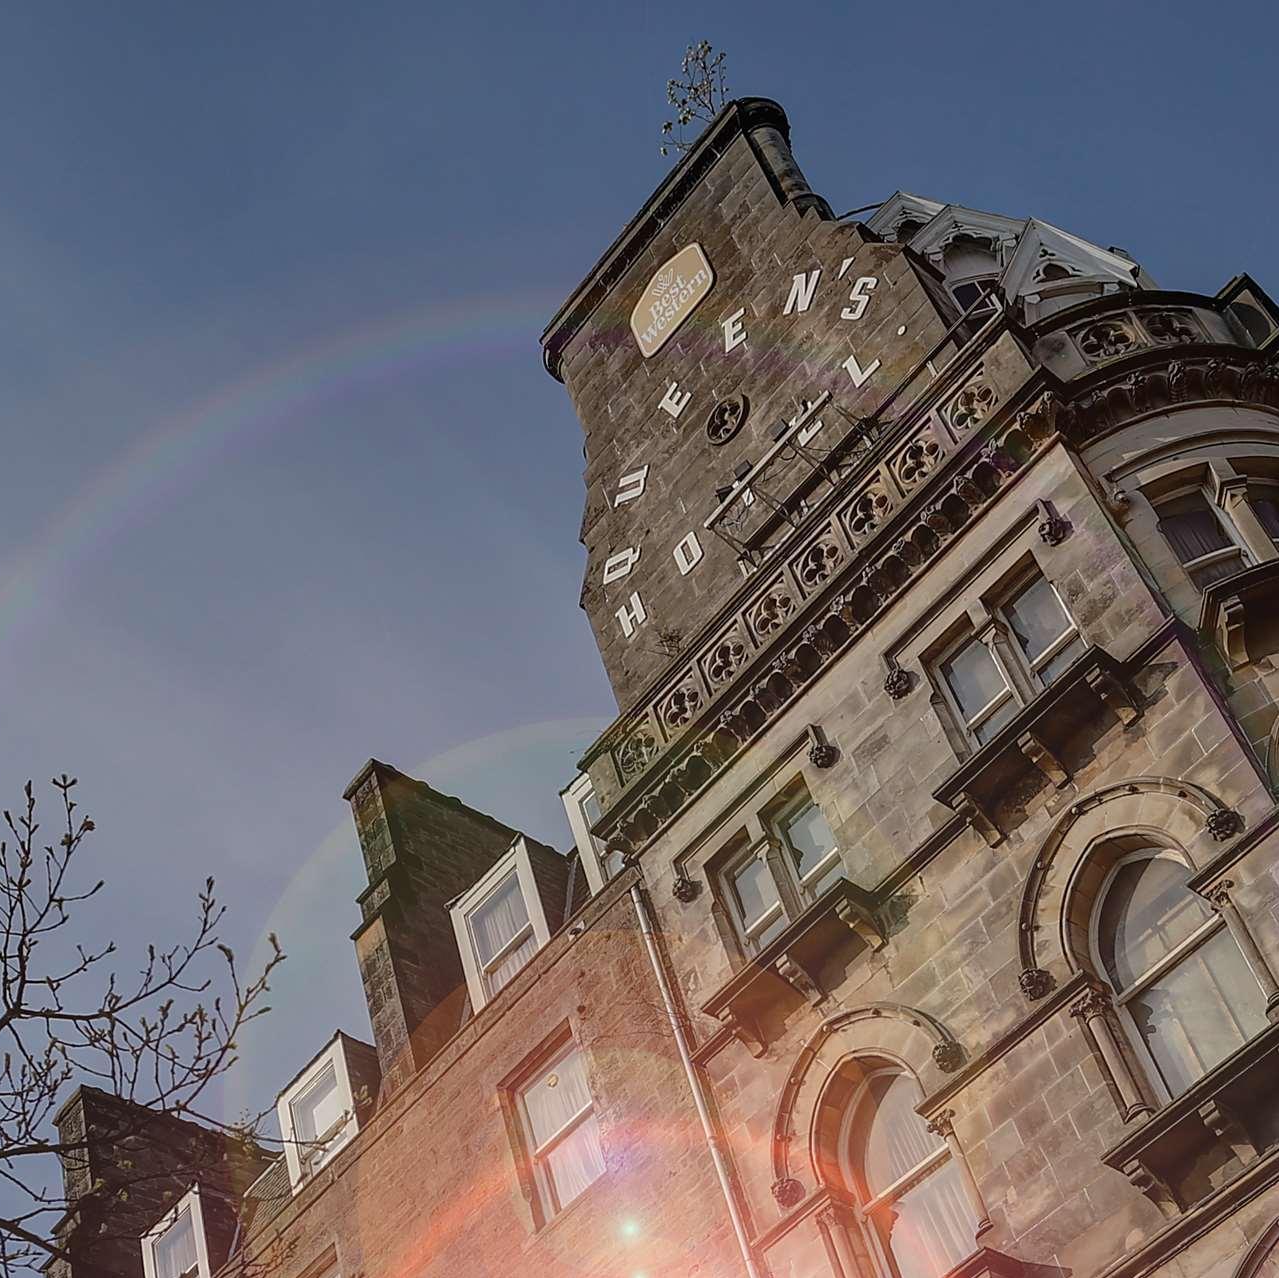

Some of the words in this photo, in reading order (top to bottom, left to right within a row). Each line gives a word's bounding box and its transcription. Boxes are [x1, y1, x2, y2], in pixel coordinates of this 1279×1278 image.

[602, 257, 878, 586] QUEEN'S
[649, 273, 687, 320] Best
[614, 324, 908, 640] HOEL.
